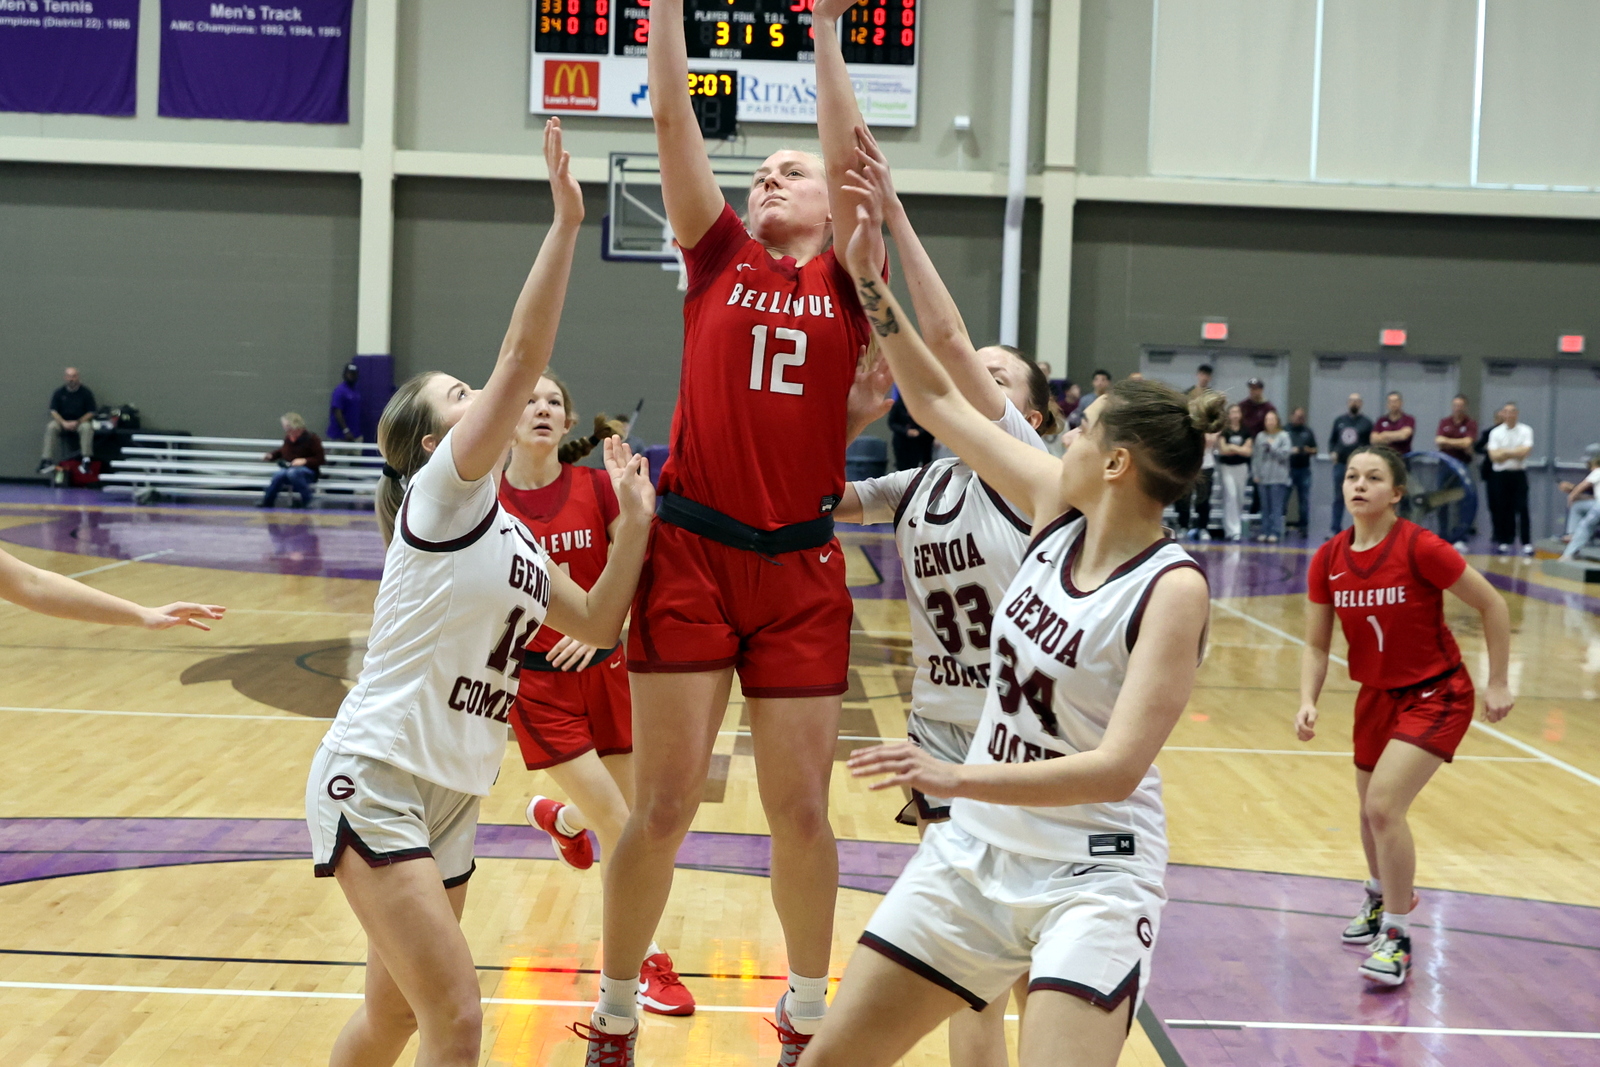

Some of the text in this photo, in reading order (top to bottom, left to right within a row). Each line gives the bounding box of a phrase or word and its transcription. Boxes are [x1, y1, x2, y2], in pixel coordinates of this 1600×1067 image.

[44, 0, 93, 14] Tennis
[210, 3, 302, 22] Men's Track
[694, 10, 729, 22] PLAYER
[733, 11, 756, 23] FOUL
[873, 8, 886, 26] 0
[901, 8, 914, 27] 0
[170, 20, 195, 32] AMC
[540, 16, 607, 36] 34 0 0
[634, 18, 650, 43] 2
[716, 22, 730, 46] 3
[769, 23, 784, 47] 5
[851, 27, 914, 47] 12 2 0
[747, 104, 815, 116] PARTNERS
[749, 324, 808, 396] 12
[914, 532, 986, 579] GENOA
[508, 553, 550, 609] GENO
[1334, 586, 1406, 608] BELLEVUE
[924, 581, 994, 655] 33
[1005, 586, 1085, 669] GENOA
[1366, 615, 1384, 652] 1
[996, 634, 1060, 739] 34
[327, 774, 356, 801] G
